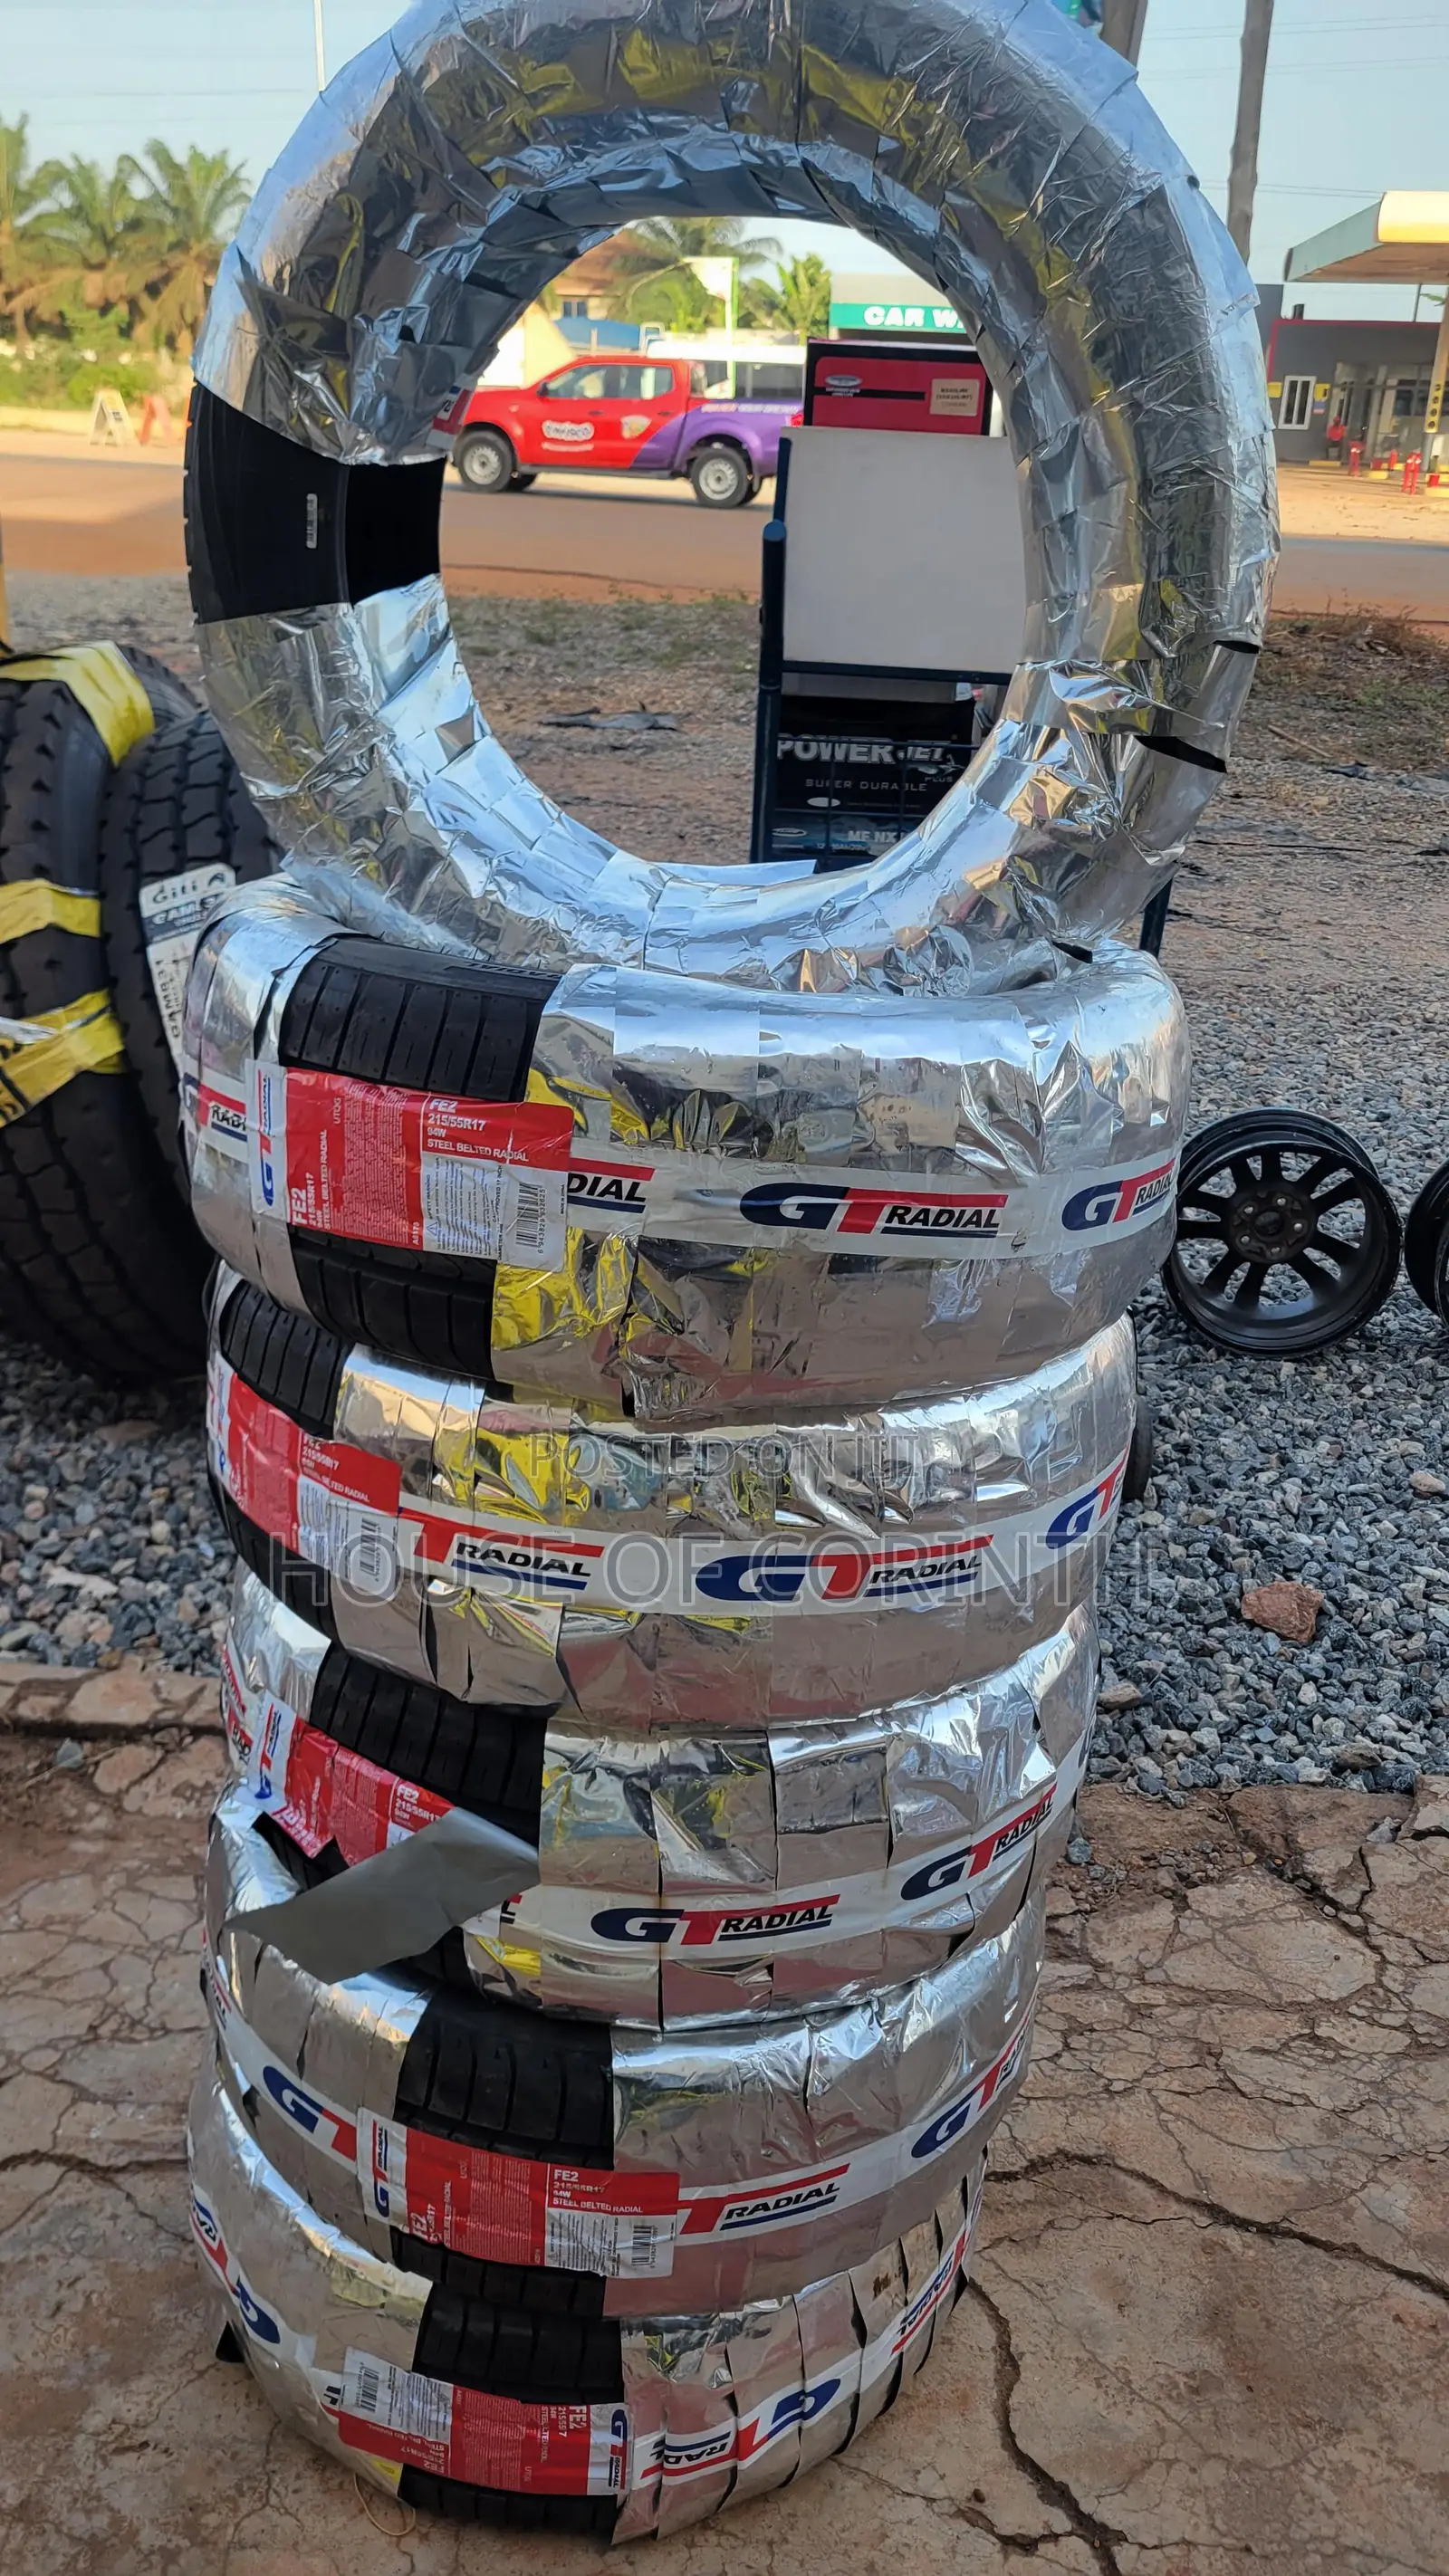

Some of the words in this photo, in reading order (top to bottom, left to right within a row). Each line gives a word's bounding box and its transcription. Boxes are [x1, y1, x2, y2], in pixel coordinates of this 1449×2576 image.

[863, 306, 925, 327] CAR
[932, 309, 964, 328] W
[777, 733, 897, 764] POWER
[427, 1113, 486, 1131] 215/55R17
[429, 1098, 459, 1114] FE2
[320, 1129, 329, 1164] RADIAL
[427, 1139, 456, 1152] STEEL
[456, 1144, 492, 1156] BELTED
[493, 1149, 530, 1163] RADIAL
[291, 1187, 308, 1225] FE2
[321, 1202, 331, 1230] STEEL
[740, 1183, 895, 1233] GT
[885, 1205, 999, 1229] RADIAL
[1061, 1178, 1138, 1231] GT
[1046, 1472, 1117, 1549] GT
[456, 1541, 592, 1578] RADIAL
[696, 1553, 875, 1601] GT
[868, 1556, 983, 1585] RADIAL
[397, 1784, 420, 1804] FE2
[900, 1834, 997, 1901] GT
[994, 1796, 1054, 1853] RADIAL
[590, 1907, 727, 1945] GT
[725, 1905, 833, 1933] RADIAL
[263, 2065, 357, 2162] GT
[911, 2063, 1002, 2159] GT
[553, 2169, 580, 2183] FE2
[552, 2197, 580, 2207] STEEL
[581, 2202, 612, 2212] BELTED
[612, 2206, 644, 2214] RADIAL
[724, 2181, 840, 2220] RADIAL
[569, 2405, 588, 2430] FE2
